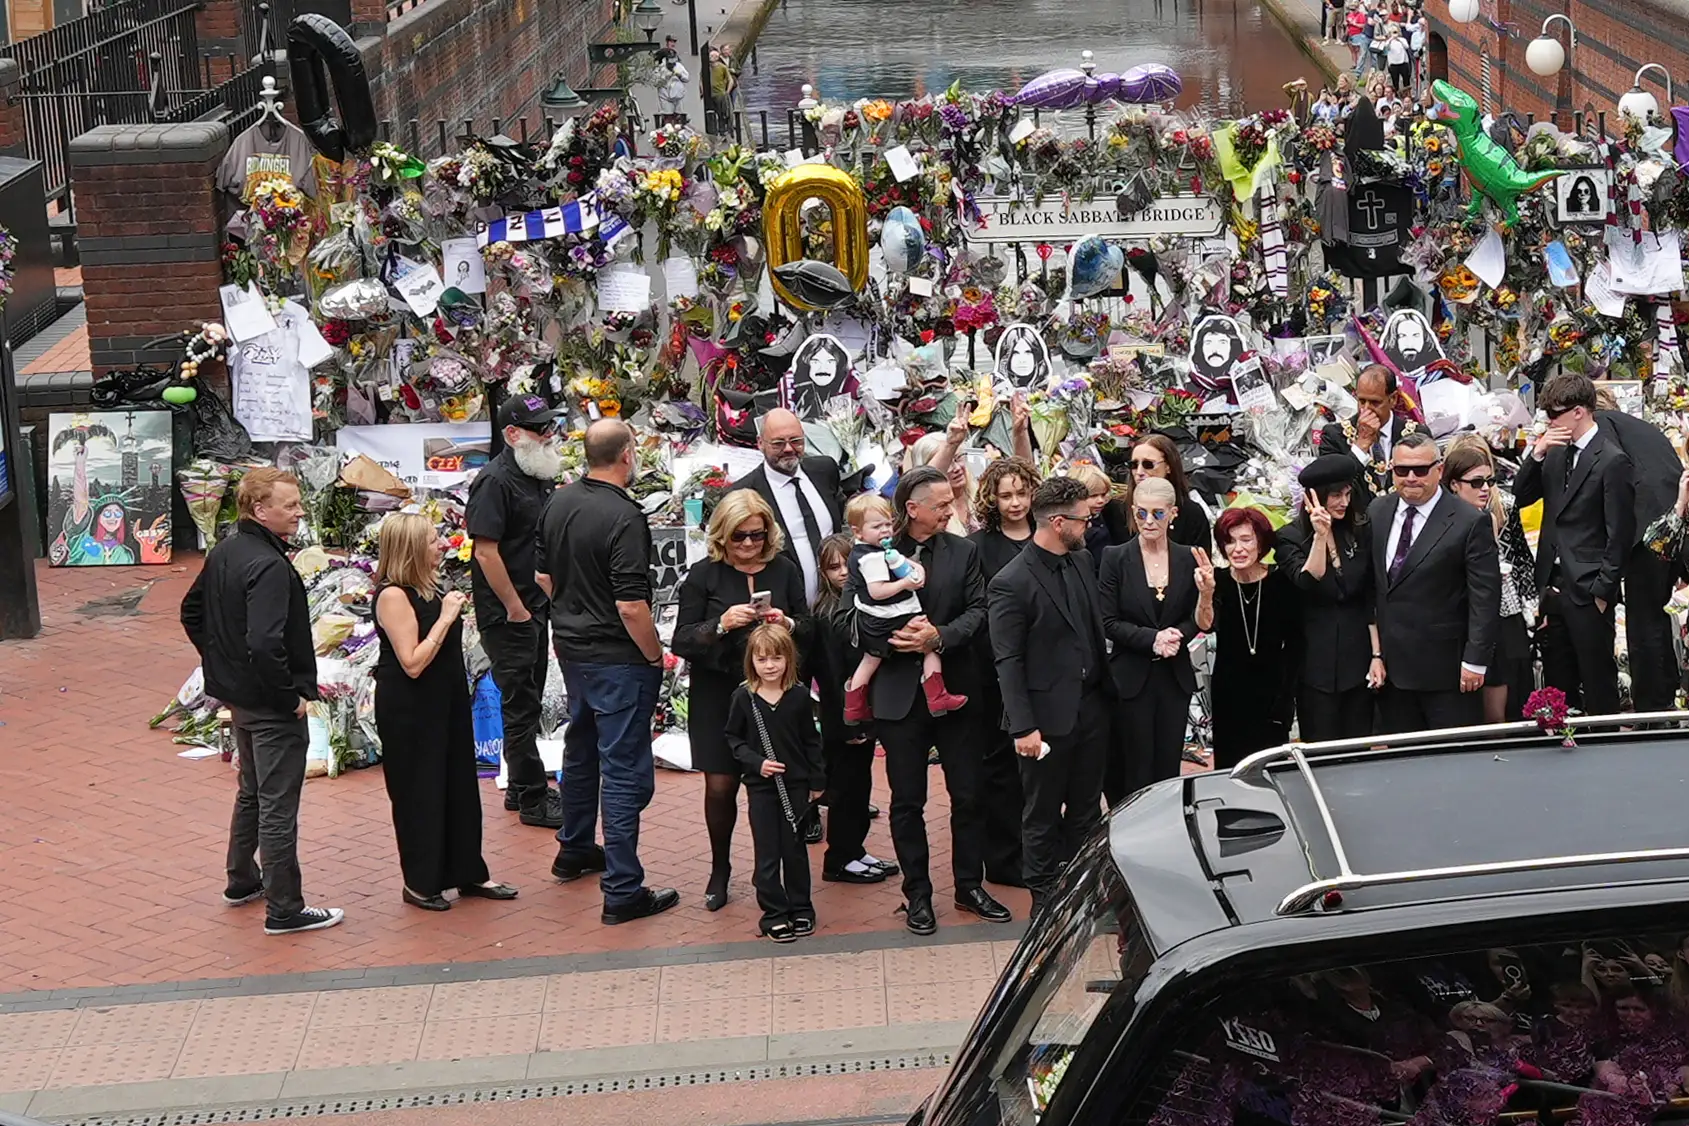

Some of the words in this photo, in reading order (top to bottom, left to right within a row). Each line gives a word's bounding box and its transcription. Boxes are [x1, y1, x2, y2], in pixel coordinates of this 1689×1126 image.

[999, 212, 1054, 225] BLACK
[1141, 207, 1205, 223] BRIDGE
[426, 455, 465, 472] OZZY
